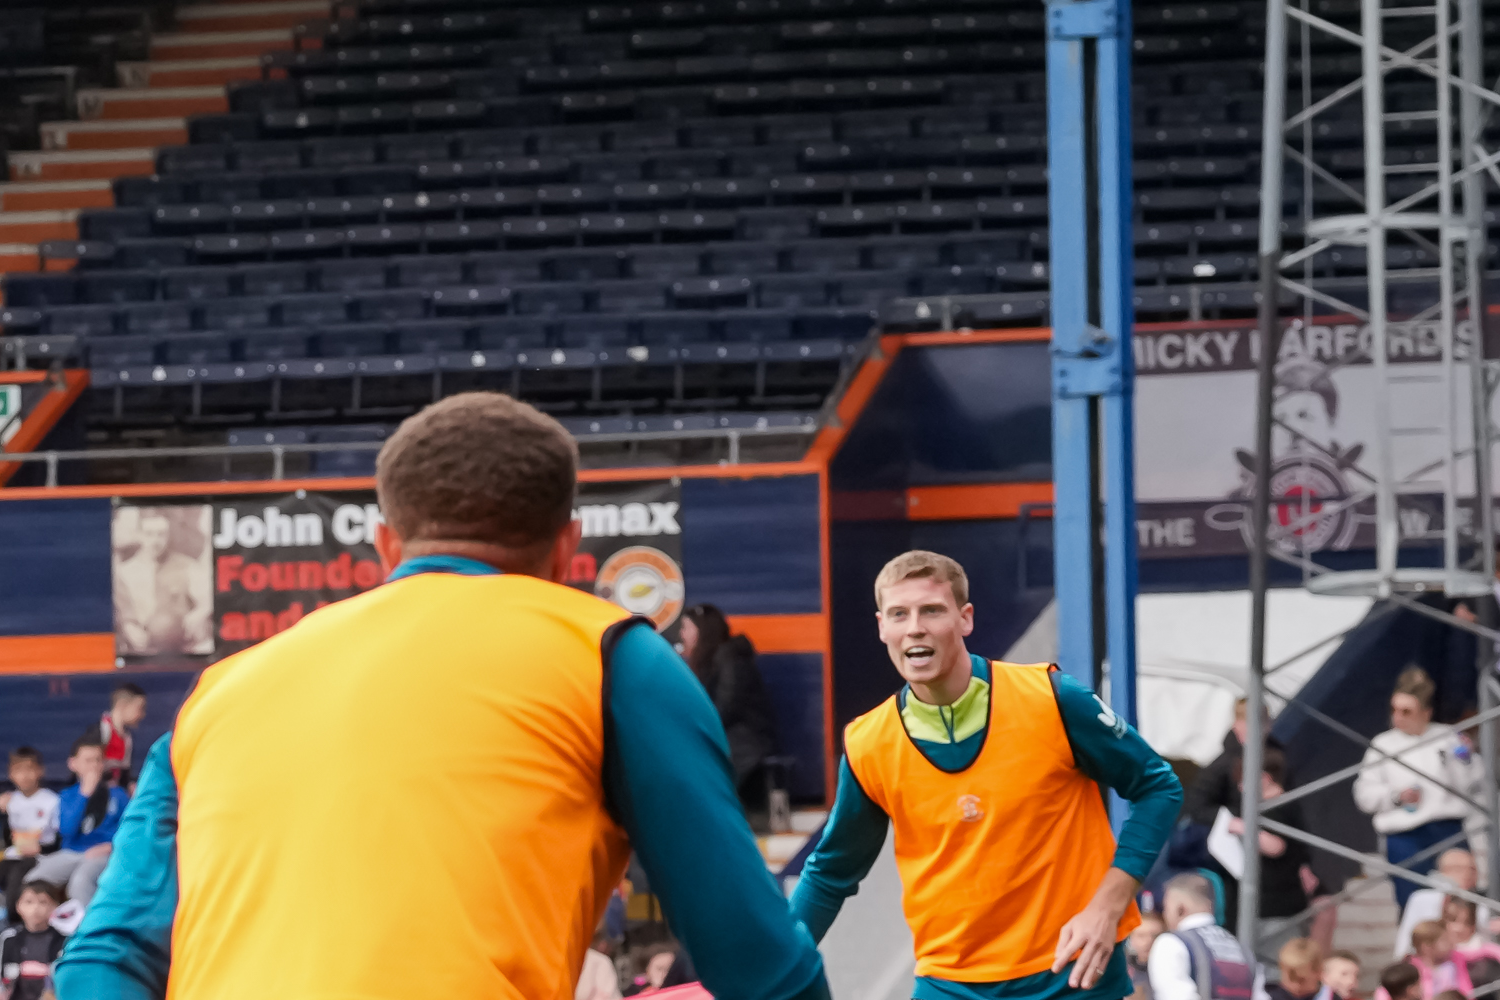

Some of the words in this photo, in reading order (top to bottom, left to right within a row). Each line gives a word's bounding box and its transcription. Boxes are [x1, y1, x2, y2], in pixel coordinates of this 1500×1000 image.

[214, 506, 324, 549] John
[570, 501, 682, 538] max
[217, 552, 388, 593] Founde
